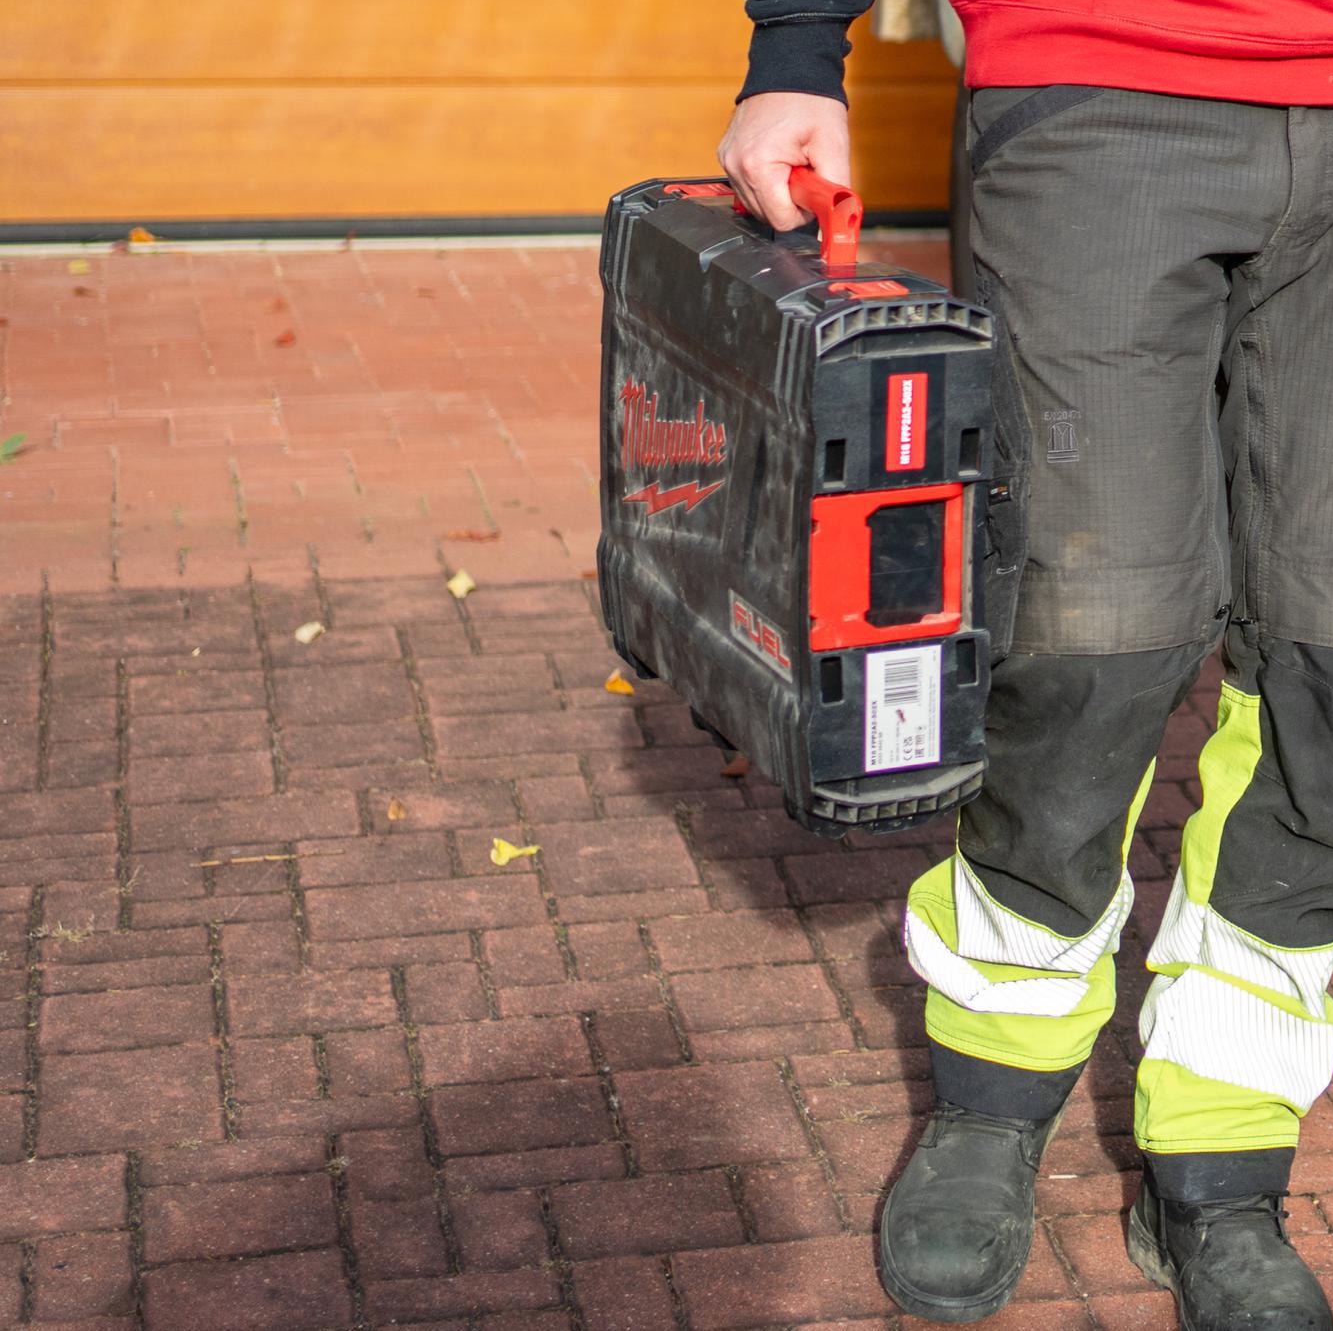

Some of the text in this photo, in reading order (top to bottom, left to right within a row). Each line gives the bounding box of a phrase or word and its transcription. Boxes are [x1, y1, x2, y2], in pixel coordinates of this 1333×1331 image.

[618, 373, 728, 473] Milwaukee
[900, 444, 911, 465] M18
[734, 600, 791, 668] FUEL
